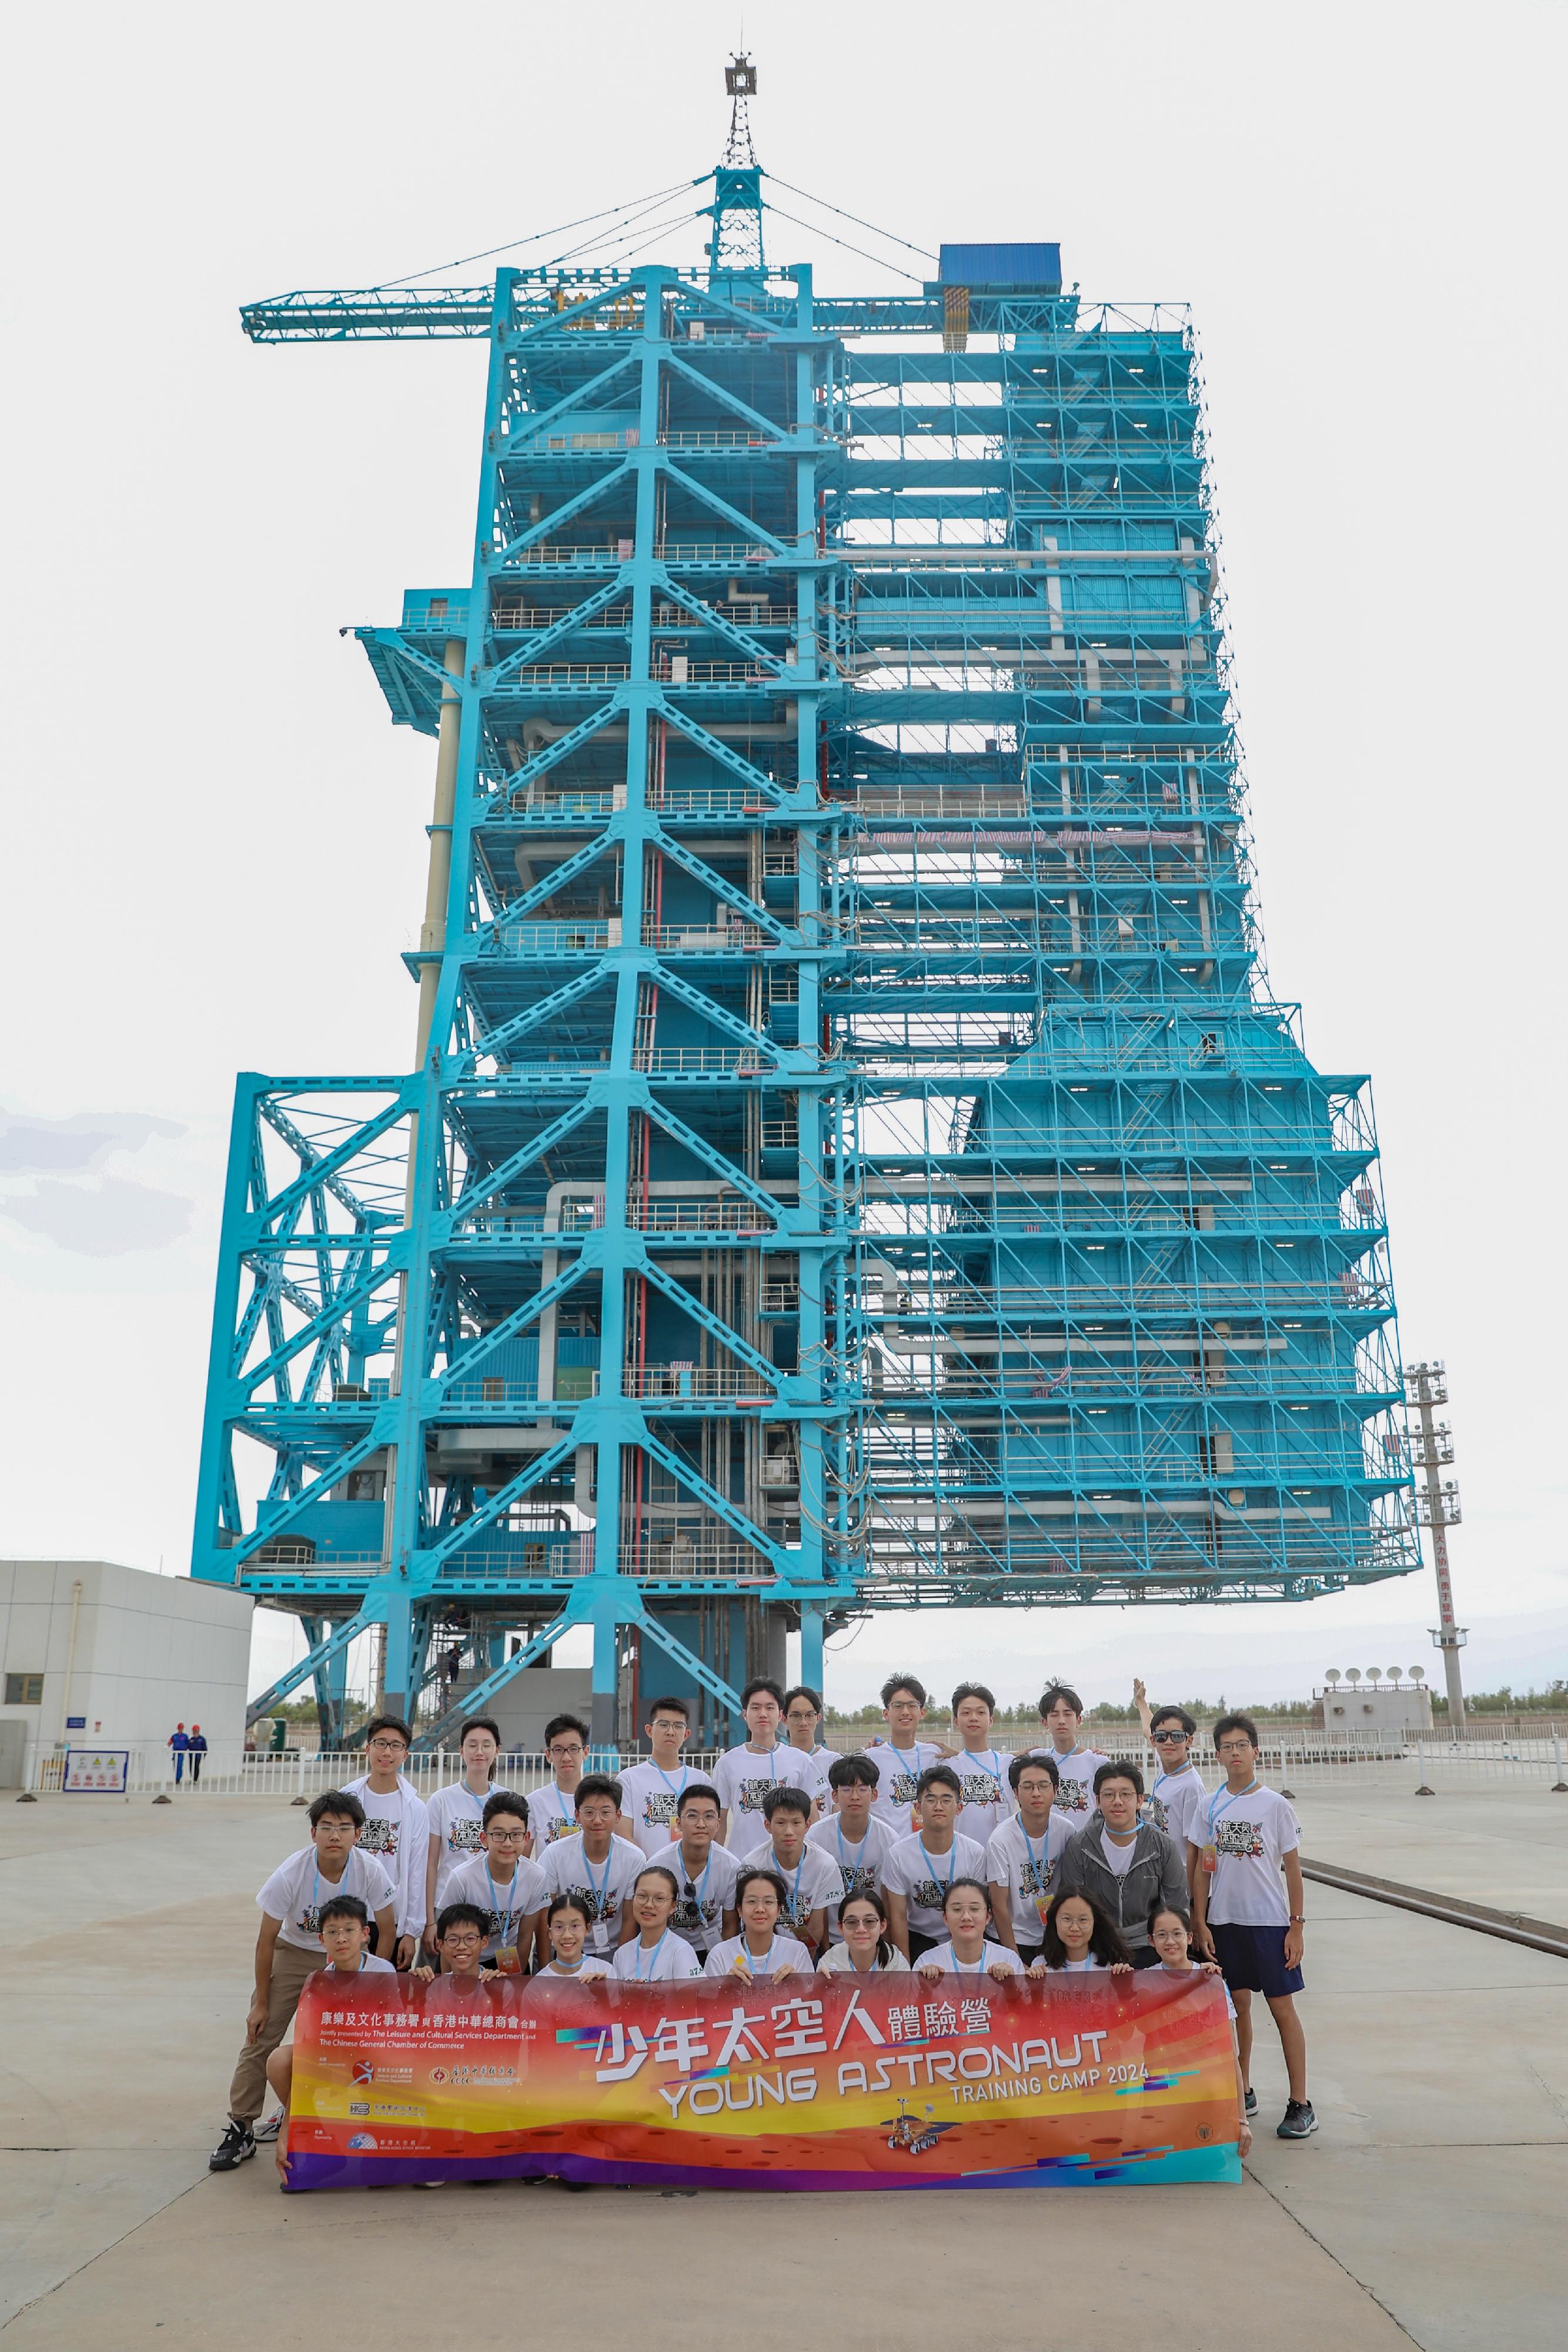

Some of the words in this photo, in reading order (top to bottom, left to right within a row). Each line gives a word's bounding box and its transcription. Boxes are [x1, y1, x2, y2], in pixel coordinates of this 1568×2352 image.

[1435, 1535, 1448, 1577] 大力协同
[965, 1775, 992, 1784] 航天员
[963, 1784, 995, 1795] 体验营
[1222, 1822, 1251, 1833] 航天员
[1221, 1832, 1253, 1844] 体验营
[484, 2032, 524, 2040] Department
[596, 1990, 885, 2082] 少年太空人
[888, 1997, 992, 2042] 體驗營
[333, 2039, 357, 2047] Chinese
[359, 2040, 386, 2048] General
[658, 2067, 817, 2119] YOUNG
[837, 2030, 1108, 2095] ASTRONAUT
[950, 2076, 1041, 2104] TRAINING
[1048, 2069, 1101, 2093] CAMP
[1107, 2063, 1149, 2084] 2024
